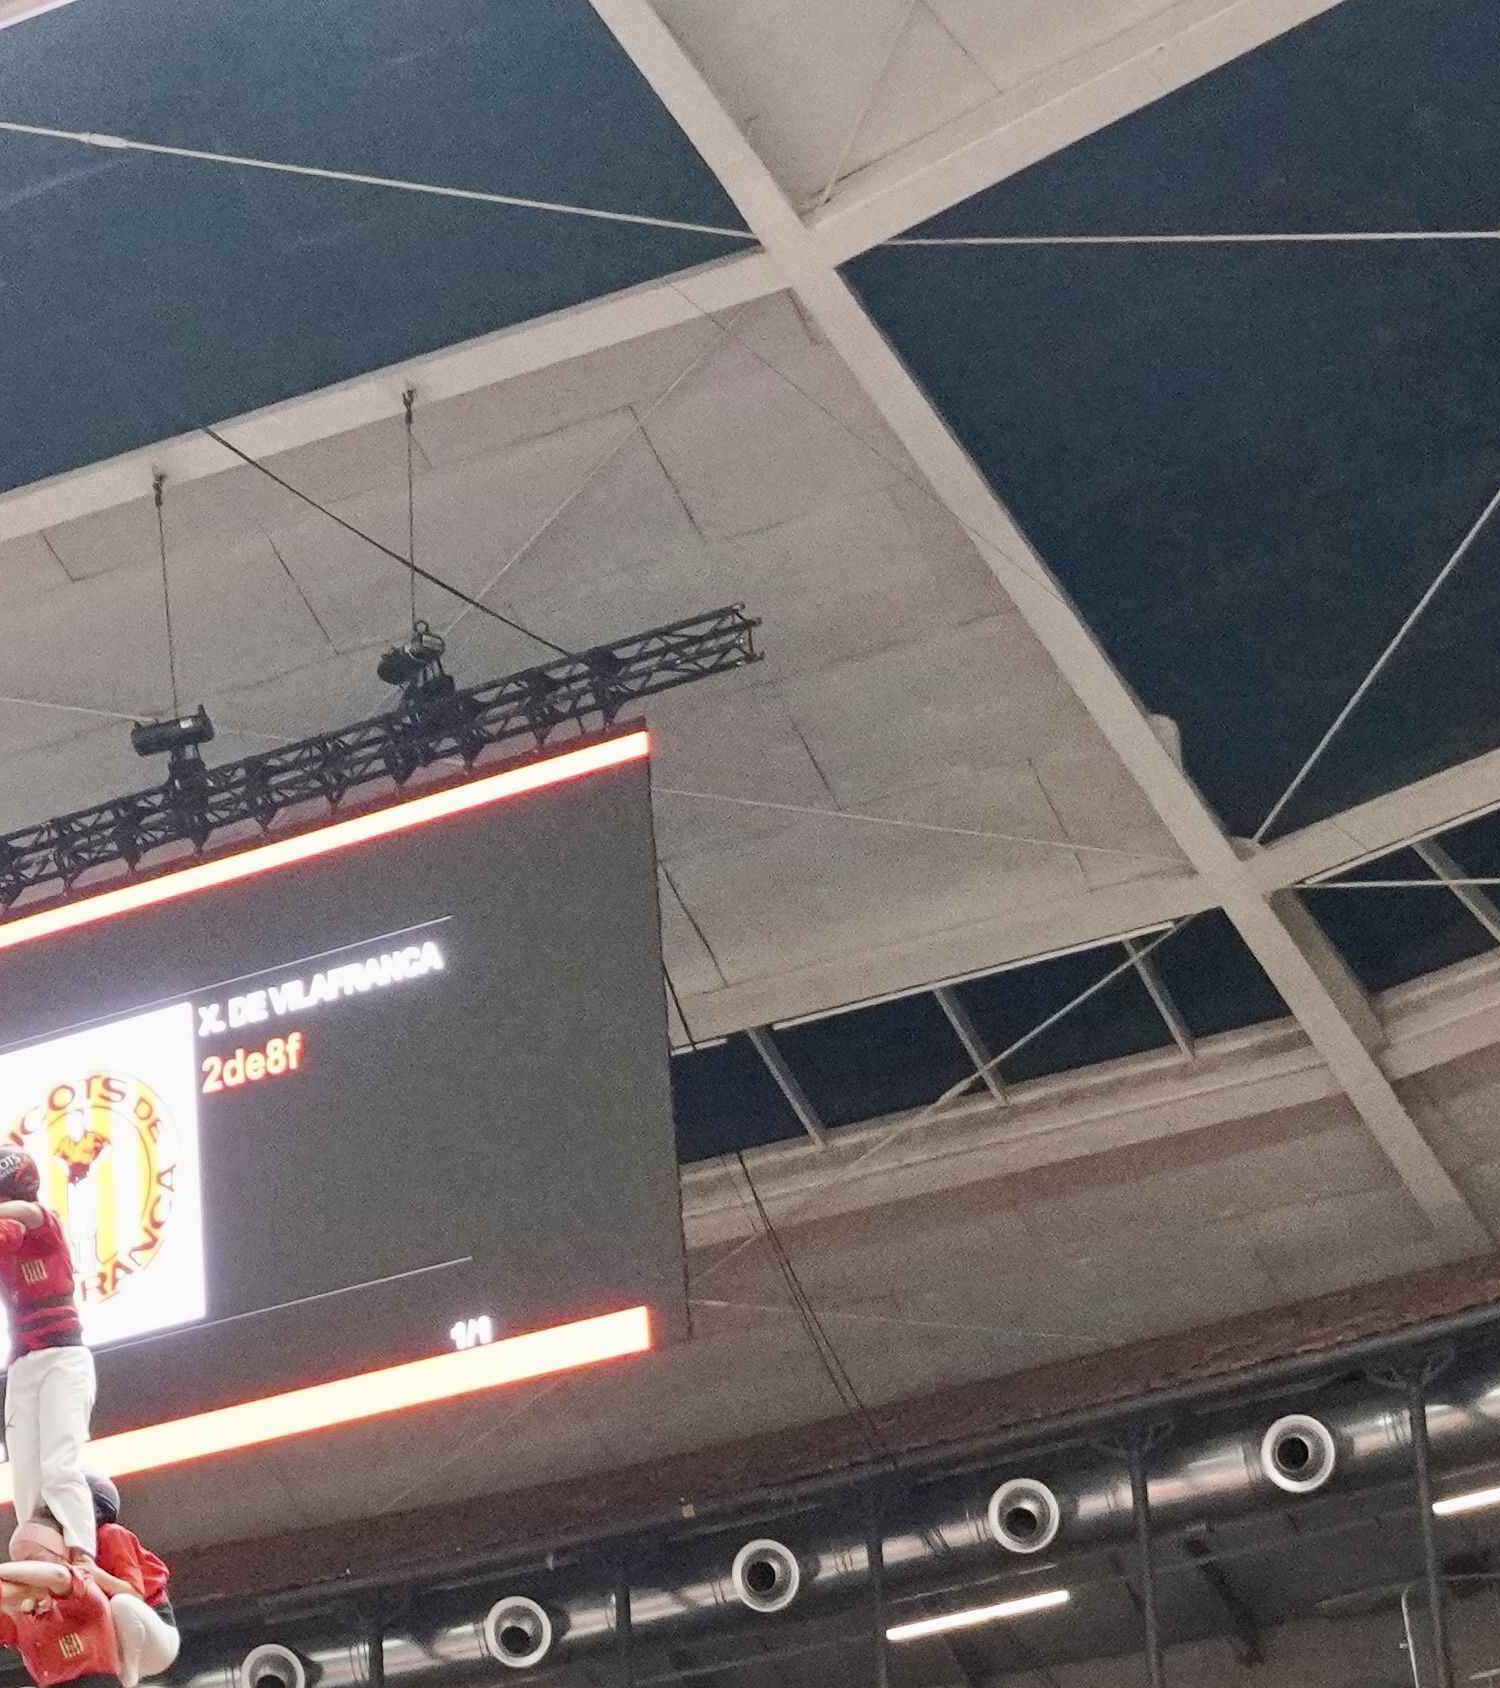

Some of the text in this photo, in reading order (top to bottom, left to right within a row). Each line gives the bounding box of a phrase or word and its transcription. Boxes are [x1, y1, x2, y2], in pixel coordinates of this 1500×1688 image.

[228, 990, 269, 1028] DE
[268, 941, 445, 1015] VILAFRANCA
[202, 1031, 302, 1093] 2de8f
